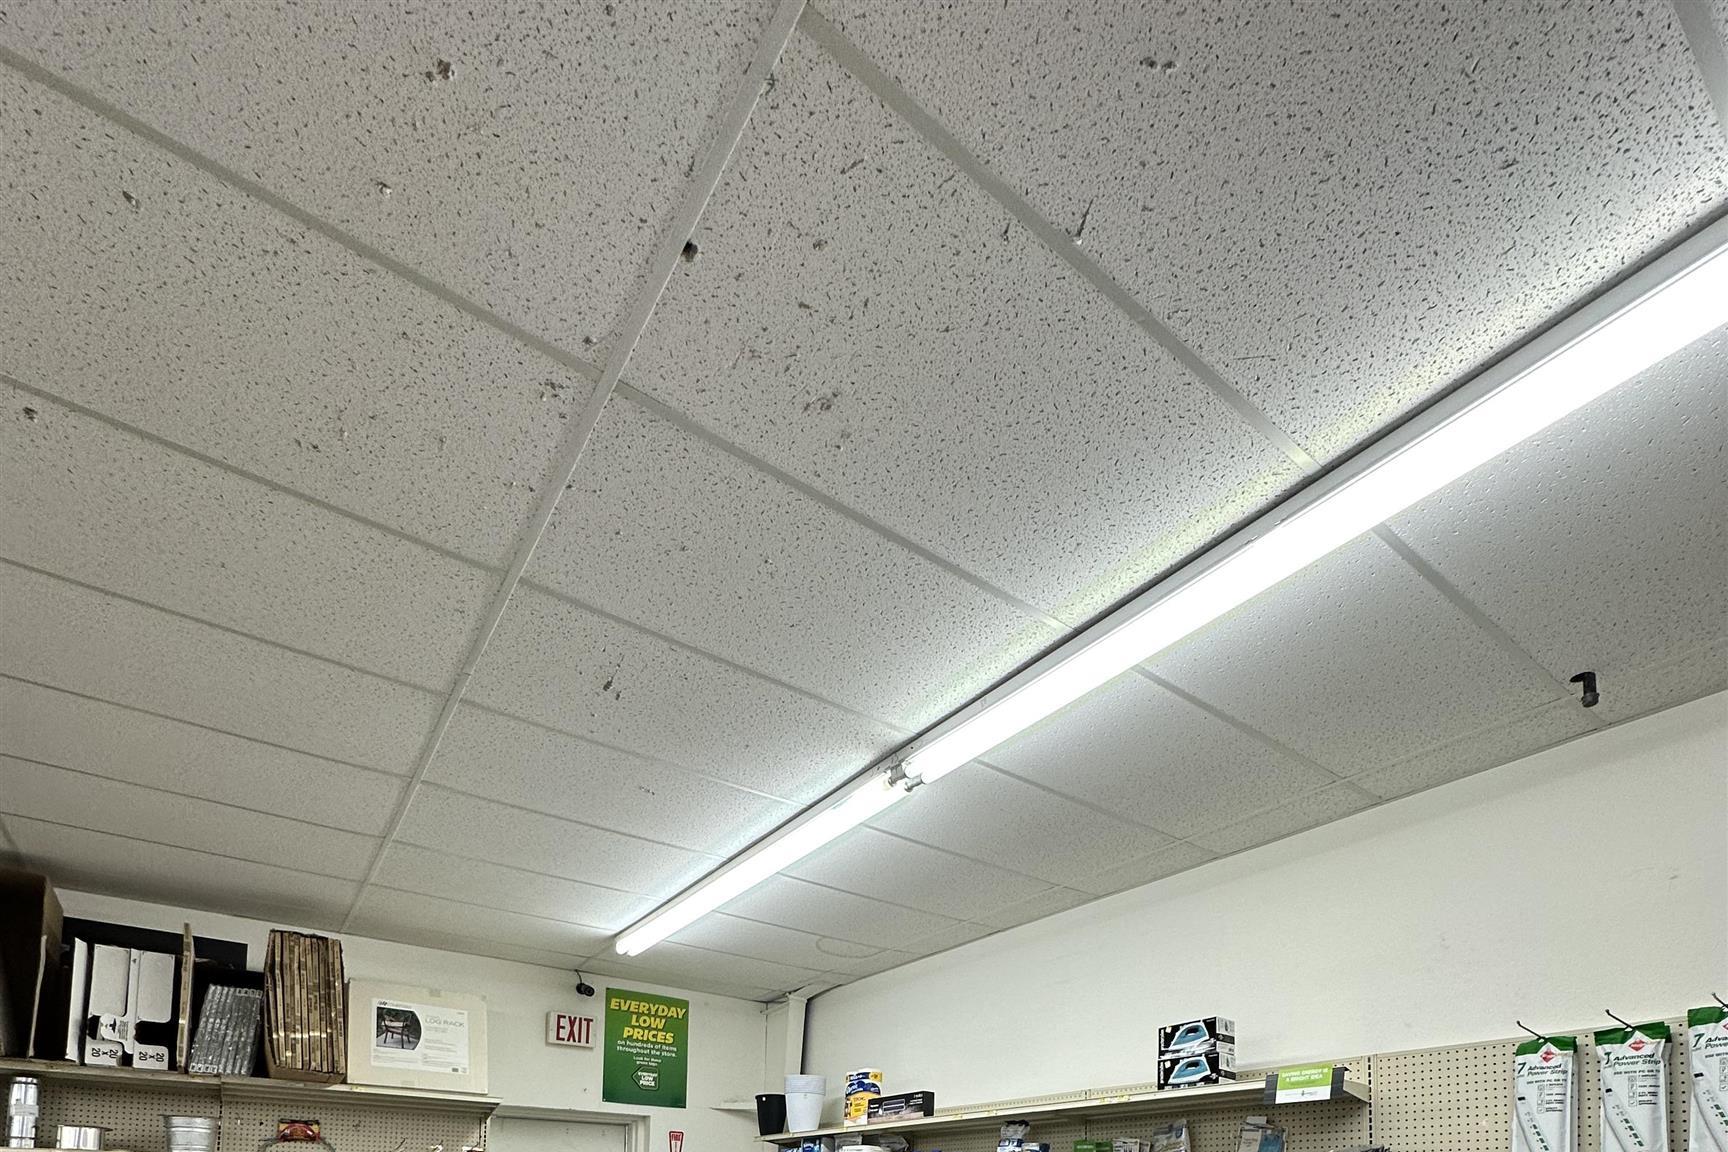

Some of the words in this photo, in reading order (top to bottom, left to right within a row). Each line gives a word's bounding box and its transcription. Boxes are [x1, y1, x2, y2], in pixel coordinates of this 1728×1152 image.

[610, 998, 686, 1019] EVERYDAY
[631, 1014, 666, 1029] LOW
[555, 1014, 594, 1044] EXIT
[623, 1027, 674, 1043] PRICES
[1693, 1033, 1705, 1048] 7
[91, 1047, 101, 1058] 20
[616, 1046, 650, 1054] throughout
[139, 1051, 147, 1061] 20
[156, 1052, 164, 1062] 20
[1613, 1052, 1655, 1062] Advanced
[1527, 1063, 1562, 1071] Advanced
[1613, 1059, 1640, 1067] Power
[1641, 1058, 1661, 1066] Strip
[1517, 1062, 1527, 1074] 7
[1527, 1069, 1549, 1077] Power
[1550, 1068, 1568, 1076] Strip
